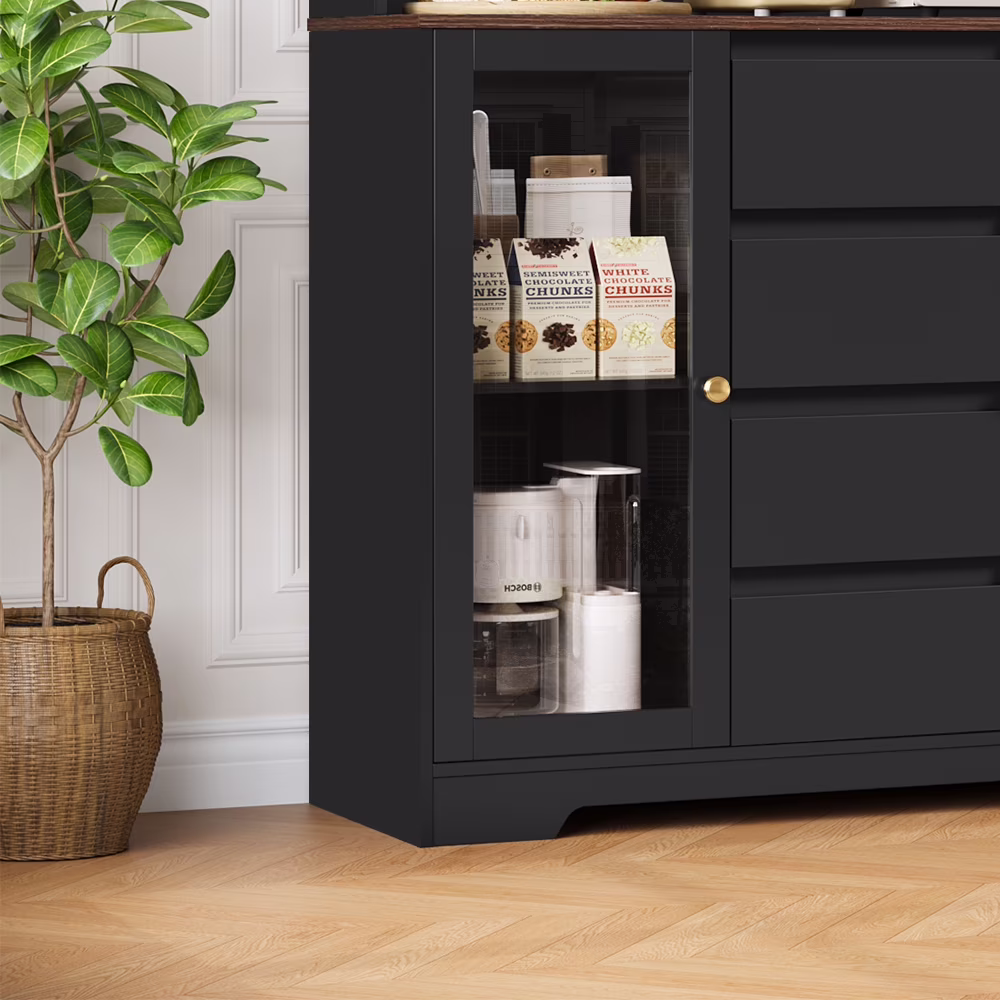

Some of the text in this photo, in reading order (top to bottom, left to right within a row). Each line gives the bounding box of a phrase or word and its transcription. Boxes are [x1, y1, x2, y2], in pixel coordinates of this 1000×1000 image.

[523, 270, 590, 278] SEMISWEET
[602, 268, 649, 276] WHITE
[525, 278, 593, 286] CHOCOLATE
[474, 287, 507, 297] NKS
[526, 286, 593, 297] CHUNKS
[605, 285, 673, 295] CHUNKS
